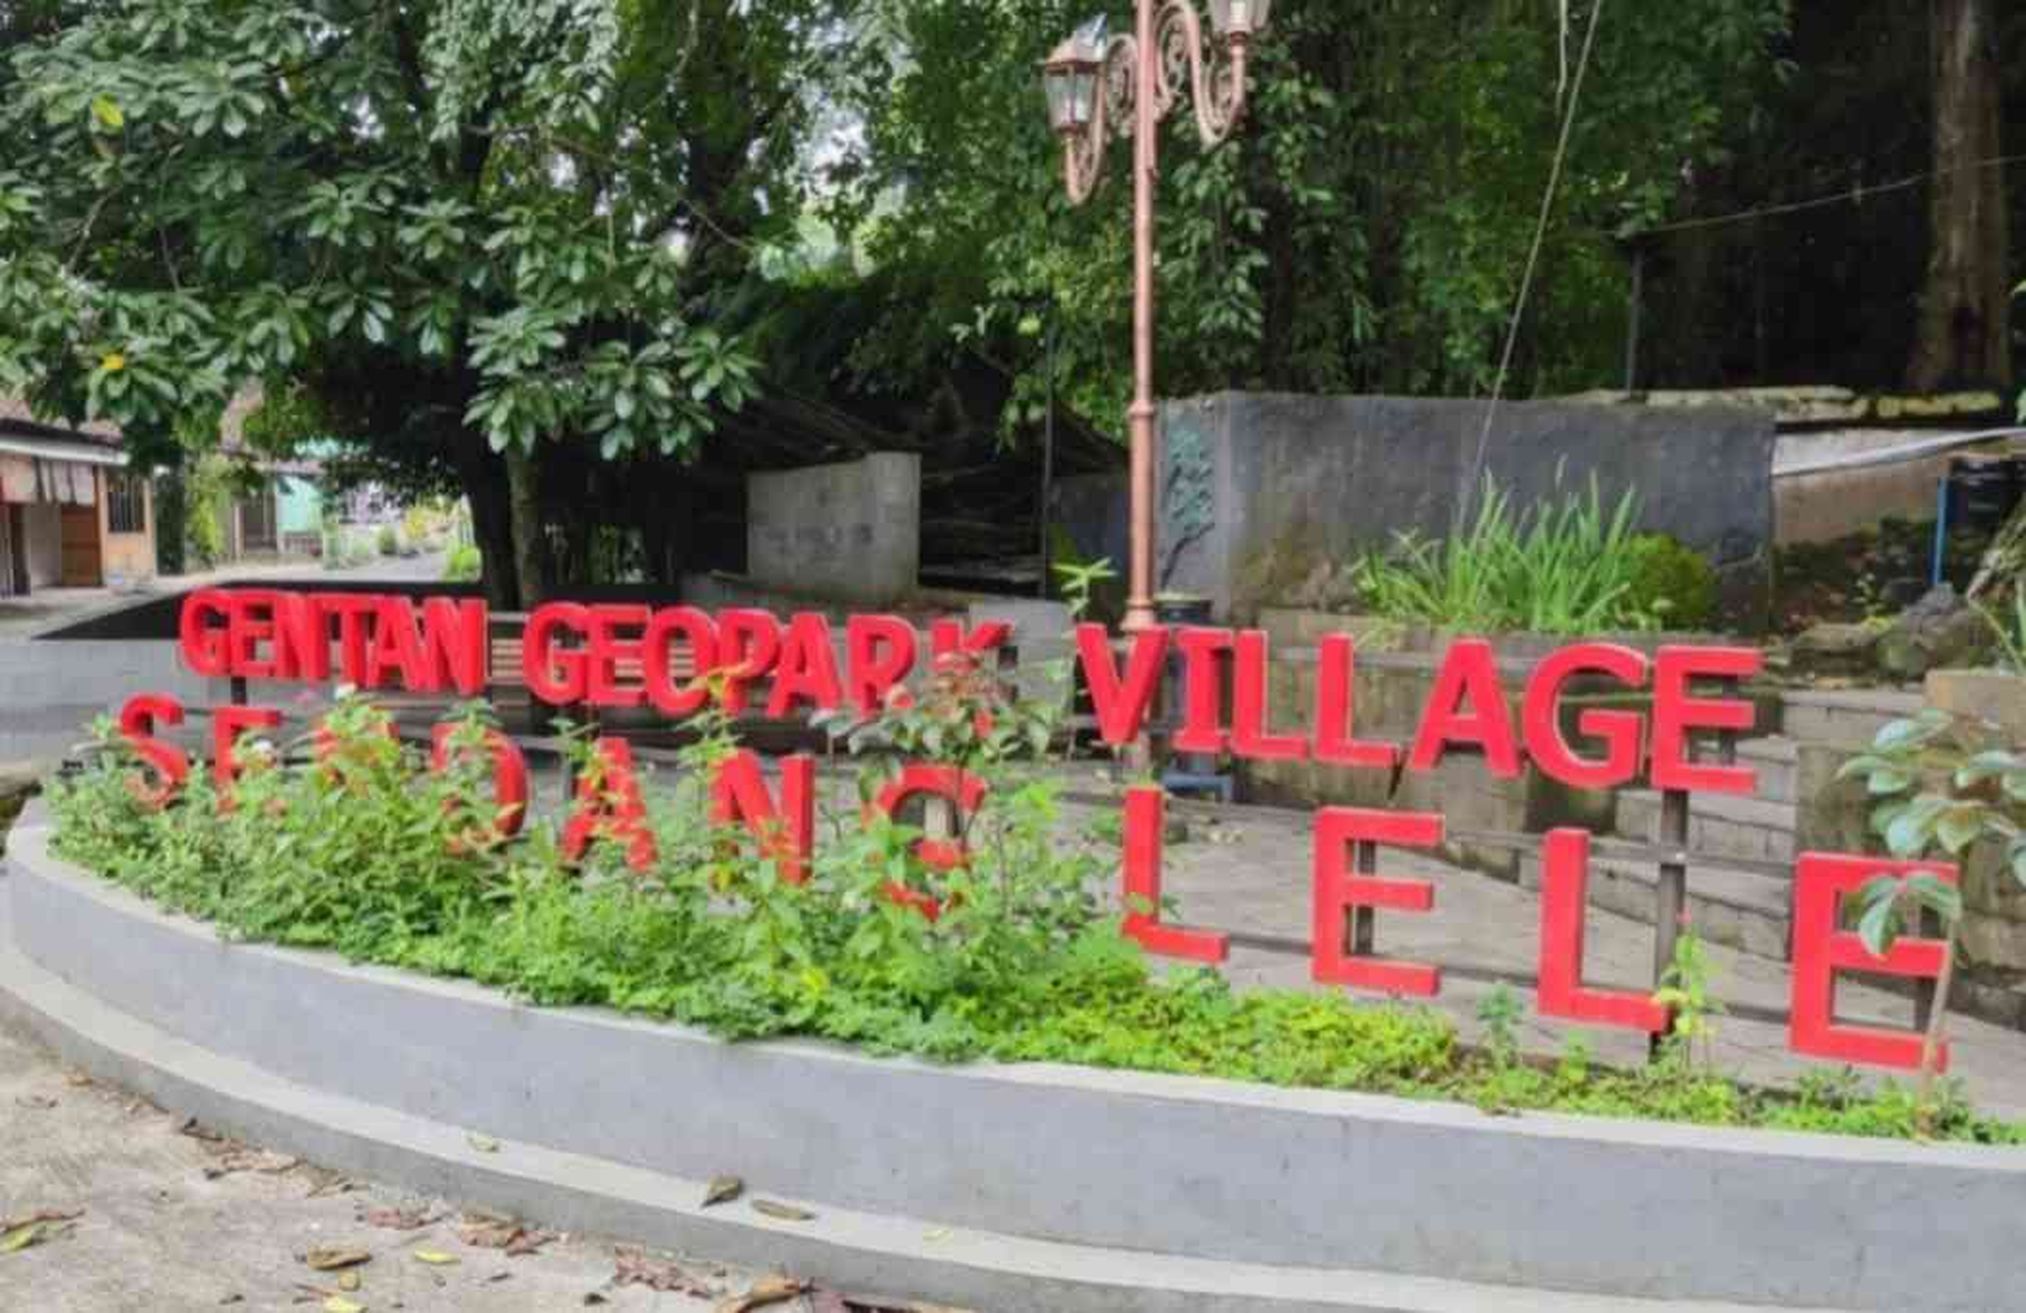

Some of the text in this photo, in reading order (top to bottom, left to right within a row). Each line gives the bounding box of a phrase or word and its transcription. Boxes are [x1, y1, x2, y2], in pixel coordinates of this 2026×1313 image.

[180, 585, 490, 696] GENTAN
[1075, 622, 1764, 794] VILLAGE
[118, 692, 1962, 1072] SEDANG LELE
